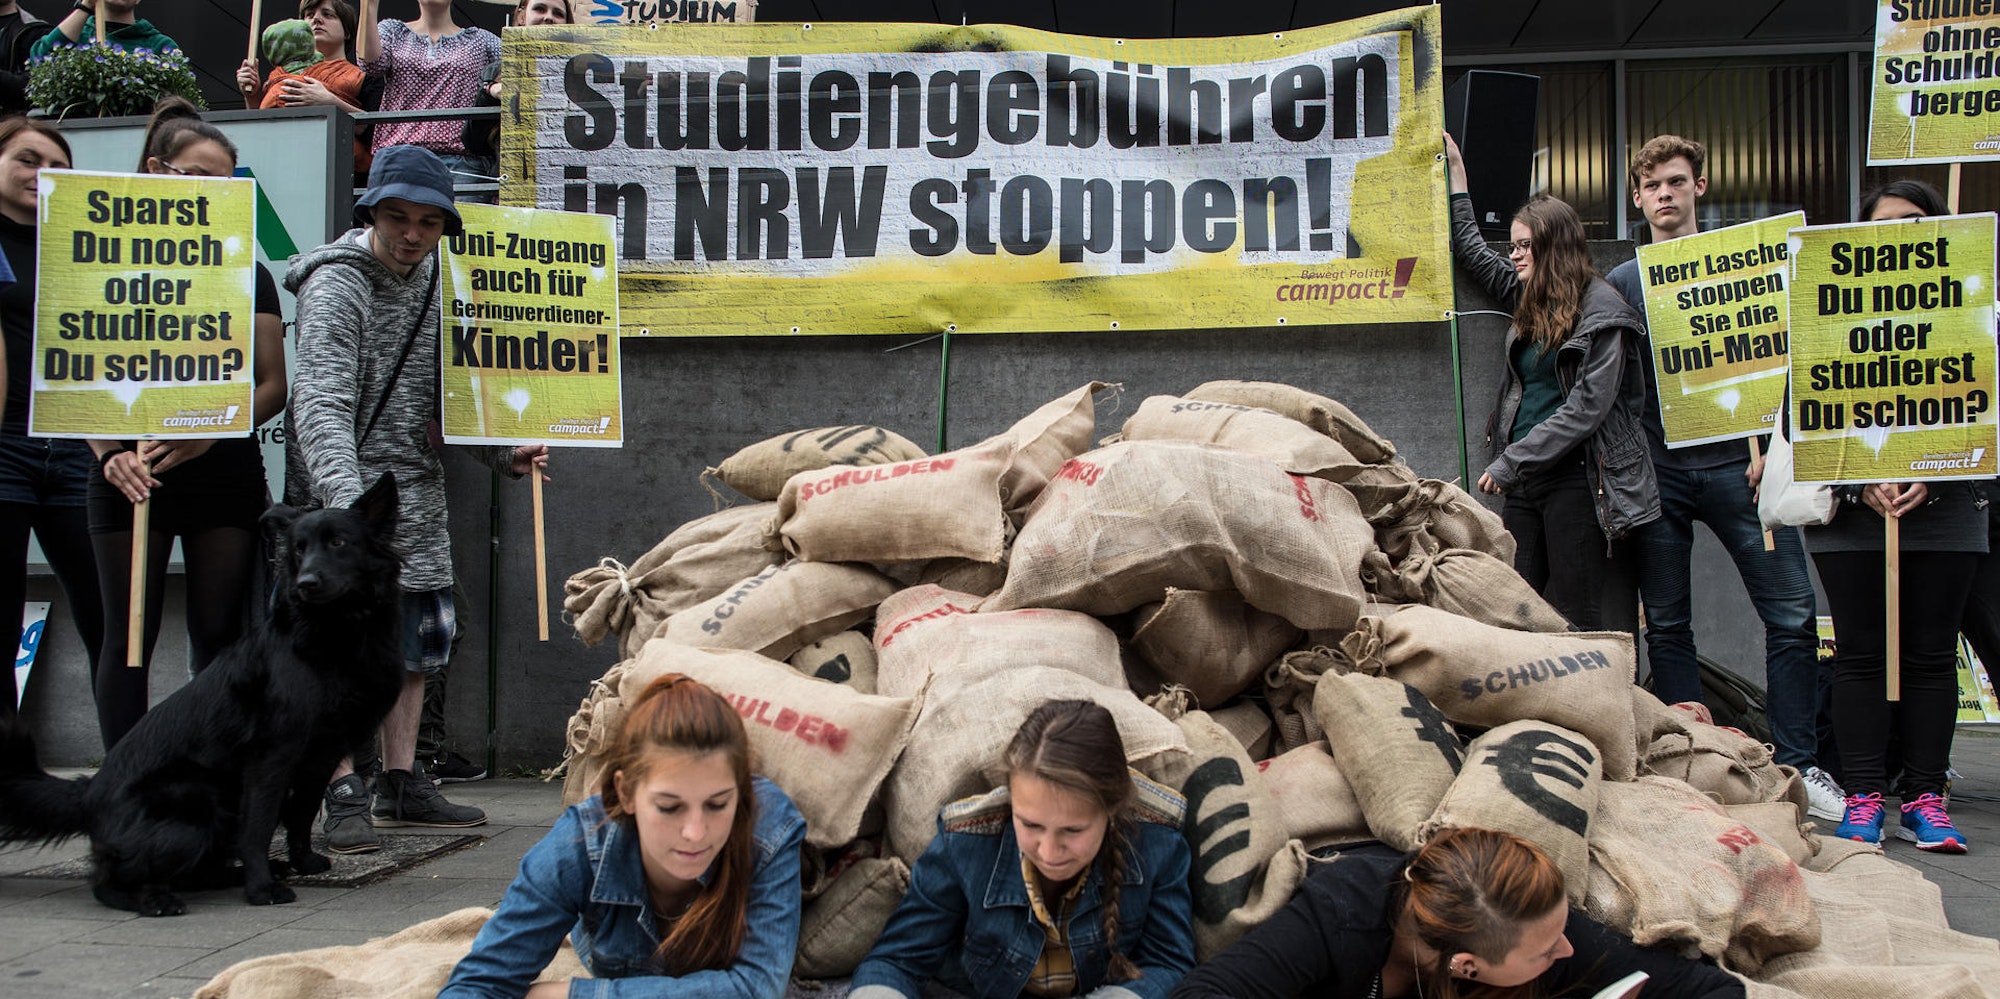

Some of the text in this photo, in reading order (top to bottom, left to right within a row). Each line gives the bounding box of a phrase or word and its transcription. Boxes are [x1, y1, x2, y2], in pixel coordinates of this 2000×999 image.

[1923, 25, 2000, 53] ohne
[564, 52, 1389, 159] Studiengebühren
[87, 189, 210, 227] Sparst
[564, 157, 1334, 264] in NRW stoppen!
[72, 230, 223, 266] Du noch
[450, 229, 606, 268] Uni-Zugang
[1648, 242, 1788, 286] Herr Lasche
[1831, 237, 1950, 277] Sparst
[104, 272, 192, 305] oder
[471, 268, 587, 297] auch für
[1276, 256, 1418, 305] campact!
[1301, 267, 1392, 281] Bewegt Politik
[1676, 271, 1783, 310] stoppen
[452, 299, 611, 326] Geringverdiener-
[1818, 275, 1963, 316] Du noch
[59, 308, 232, 341] studierst
[1689, 304, 1778, 337] Sie die
[1849, 319, 1932, 354] oder
[44, 347, 244, 382] Du schon?
[452, 325, 609, 374] Kinder!
[1661, 330, 1788, 375] Uni-Mau
[1810, 352, 1975, 391] studierst
[162, 405, 240, 428] campact!
[548, 416, 611, 435] campact!
[1800, 389, 1989, 431] Du schon?
[1910, 448, 1986, 473] campact!
[1460, 650, 1612, 701] SCHULDEN
